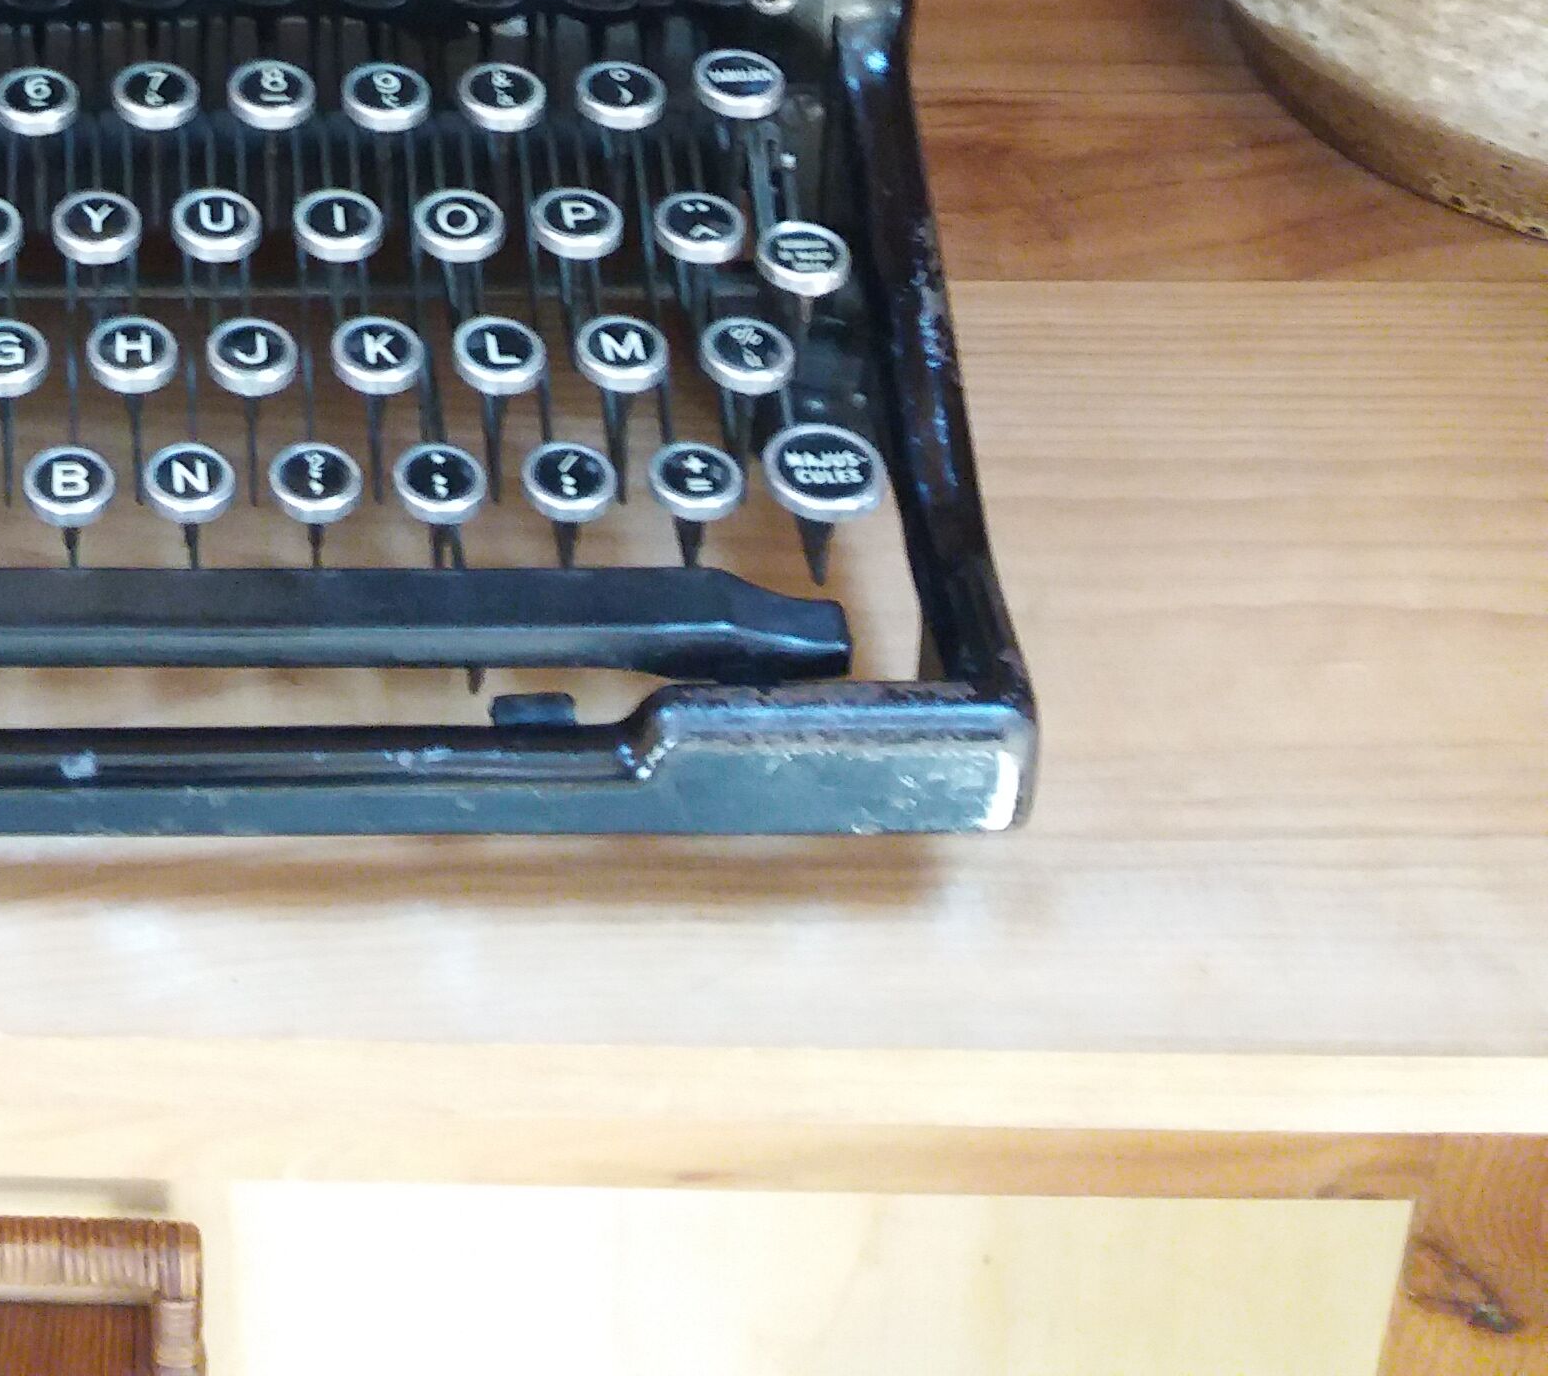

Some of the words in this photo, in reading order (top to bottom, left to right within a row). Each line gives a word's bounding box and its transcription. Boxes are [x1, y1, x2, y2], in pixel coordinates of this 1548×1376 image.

[23, 76, 53, 100] 6
[143, 71, 170, 94] 7
[259, 67, 289, 92] 8
[371, 71, 402, 96] 9
[81, 203, 114, 233] Y
[198, 201, 235, 233] U
[332, 203, 346, 232] I
[436, 203, 479, 236] O
[560, 200, 598, 229] P
[114, 331, 153, 363] H
[232, 332, 269, 365] J
[362, 332, 400, 365] K
[484, 332, 522, 365] L
[598, 330, 647, 362] M
[51, 461, 90, 497] B
[171, 459, 210, 494] N
